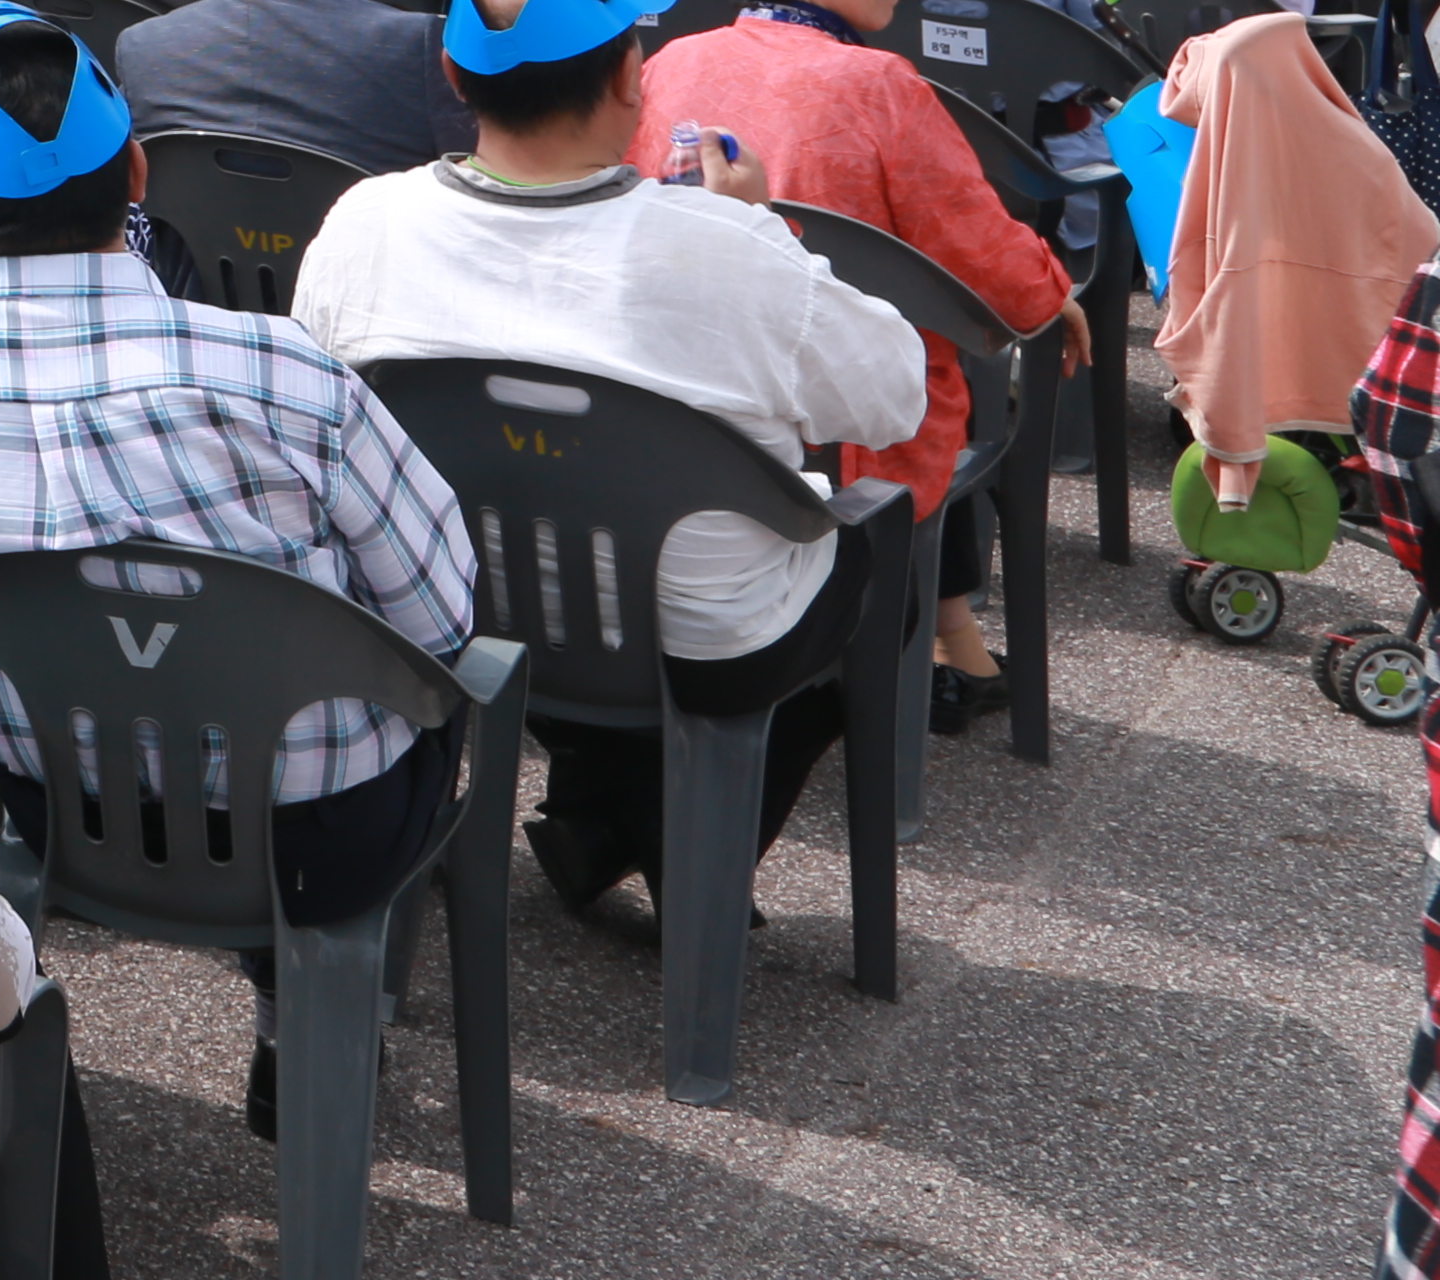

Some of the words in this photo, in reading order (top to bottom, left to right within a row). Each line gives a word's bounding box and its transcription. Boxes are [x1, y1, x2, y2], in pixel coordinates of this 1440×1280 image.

[935, 27, 969, 40] F5구역
[931, 42, 951, 56] 8열
[963, 44, 985, 60] 6번
[235, 226, 294, 253] VIP
